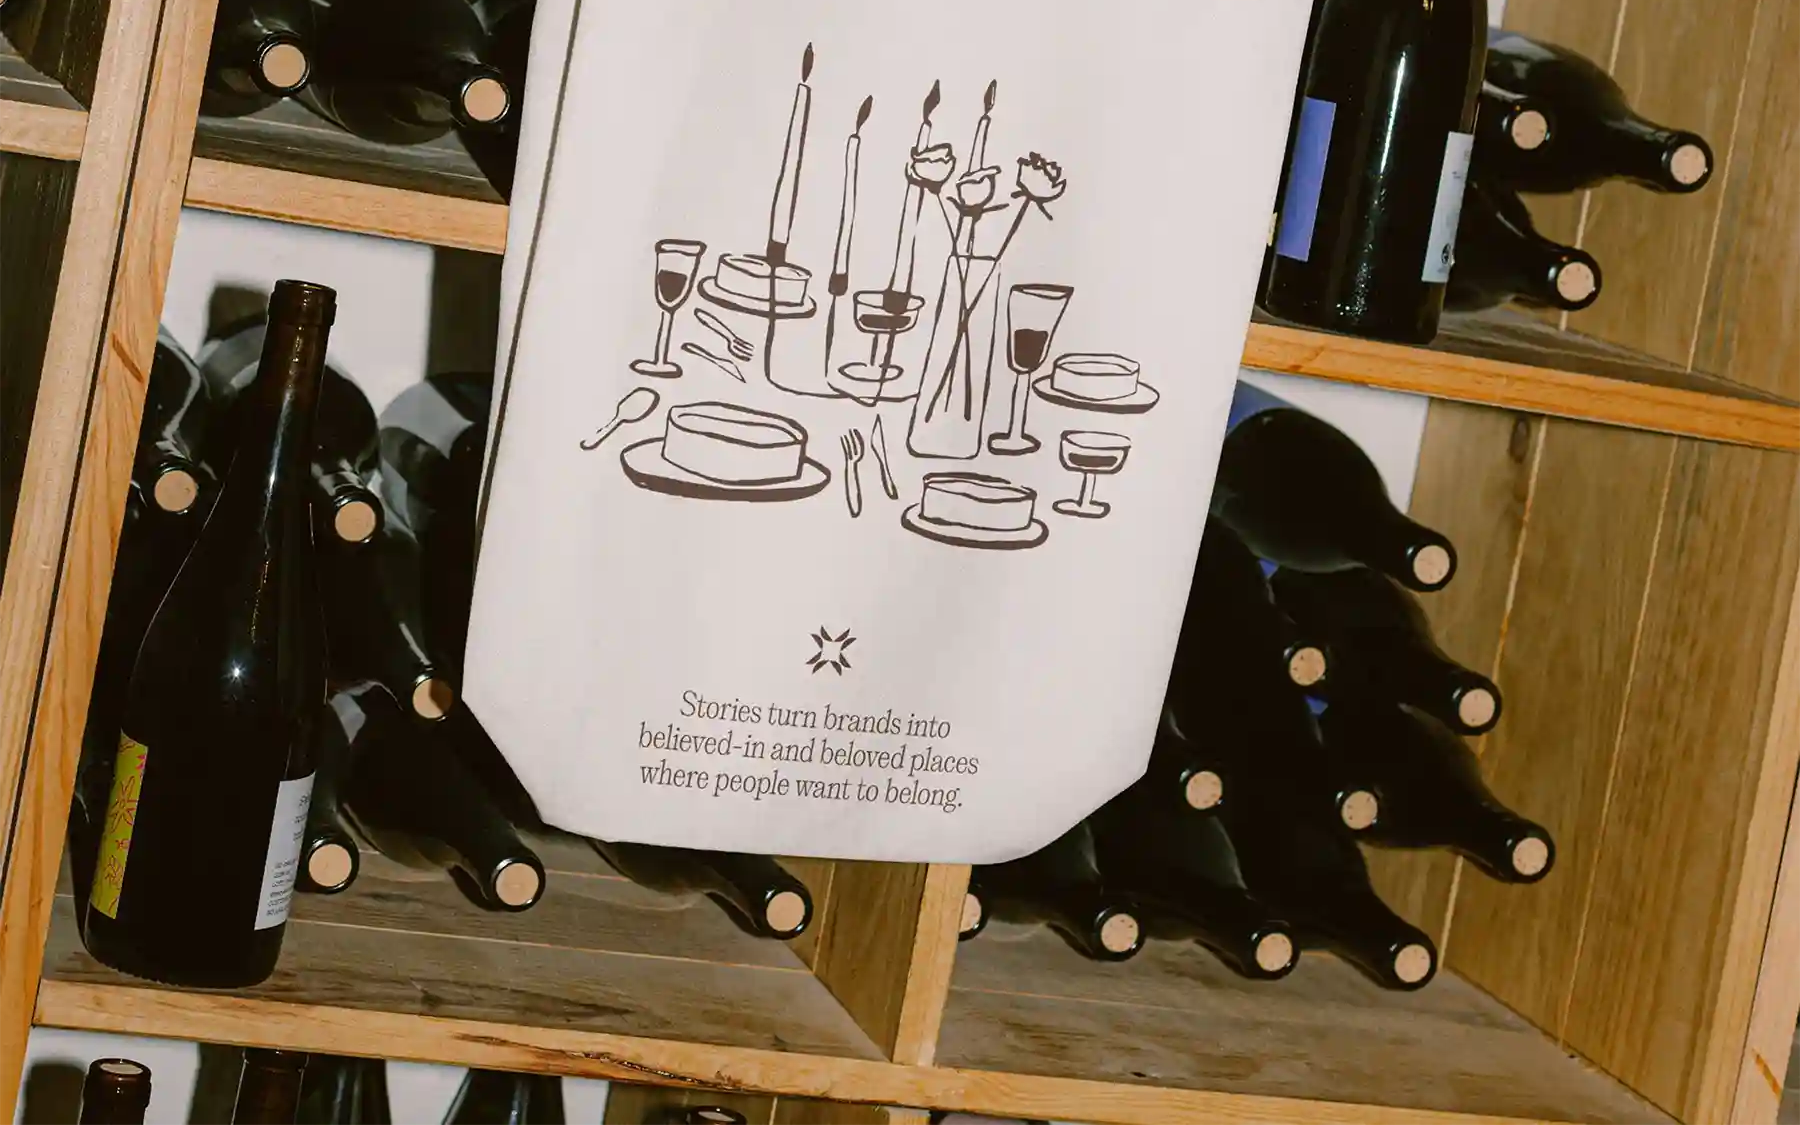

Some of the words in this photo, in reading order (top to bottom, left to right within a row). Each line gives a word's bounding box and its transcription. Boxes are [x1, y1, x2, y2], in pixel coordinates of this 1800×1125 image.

[680, 690, 762, 725] Stories
[767, 702, 818, 729] turn
[823, 703, 902, 736] brands
[905, 712, 952, 739] into
[638, 722, 765, 760] believed-in
[770, 737, 816, 765] and
[819, 739, 906, 771] beloved
[908, 746, 980, 778] places
[639, 759, 710, 791] where
[712, 769, 790, 802] people
[795, 777, 852, 803] want
[856, 777, 880, 804] to
[884, 777, 964, 815] belong.
